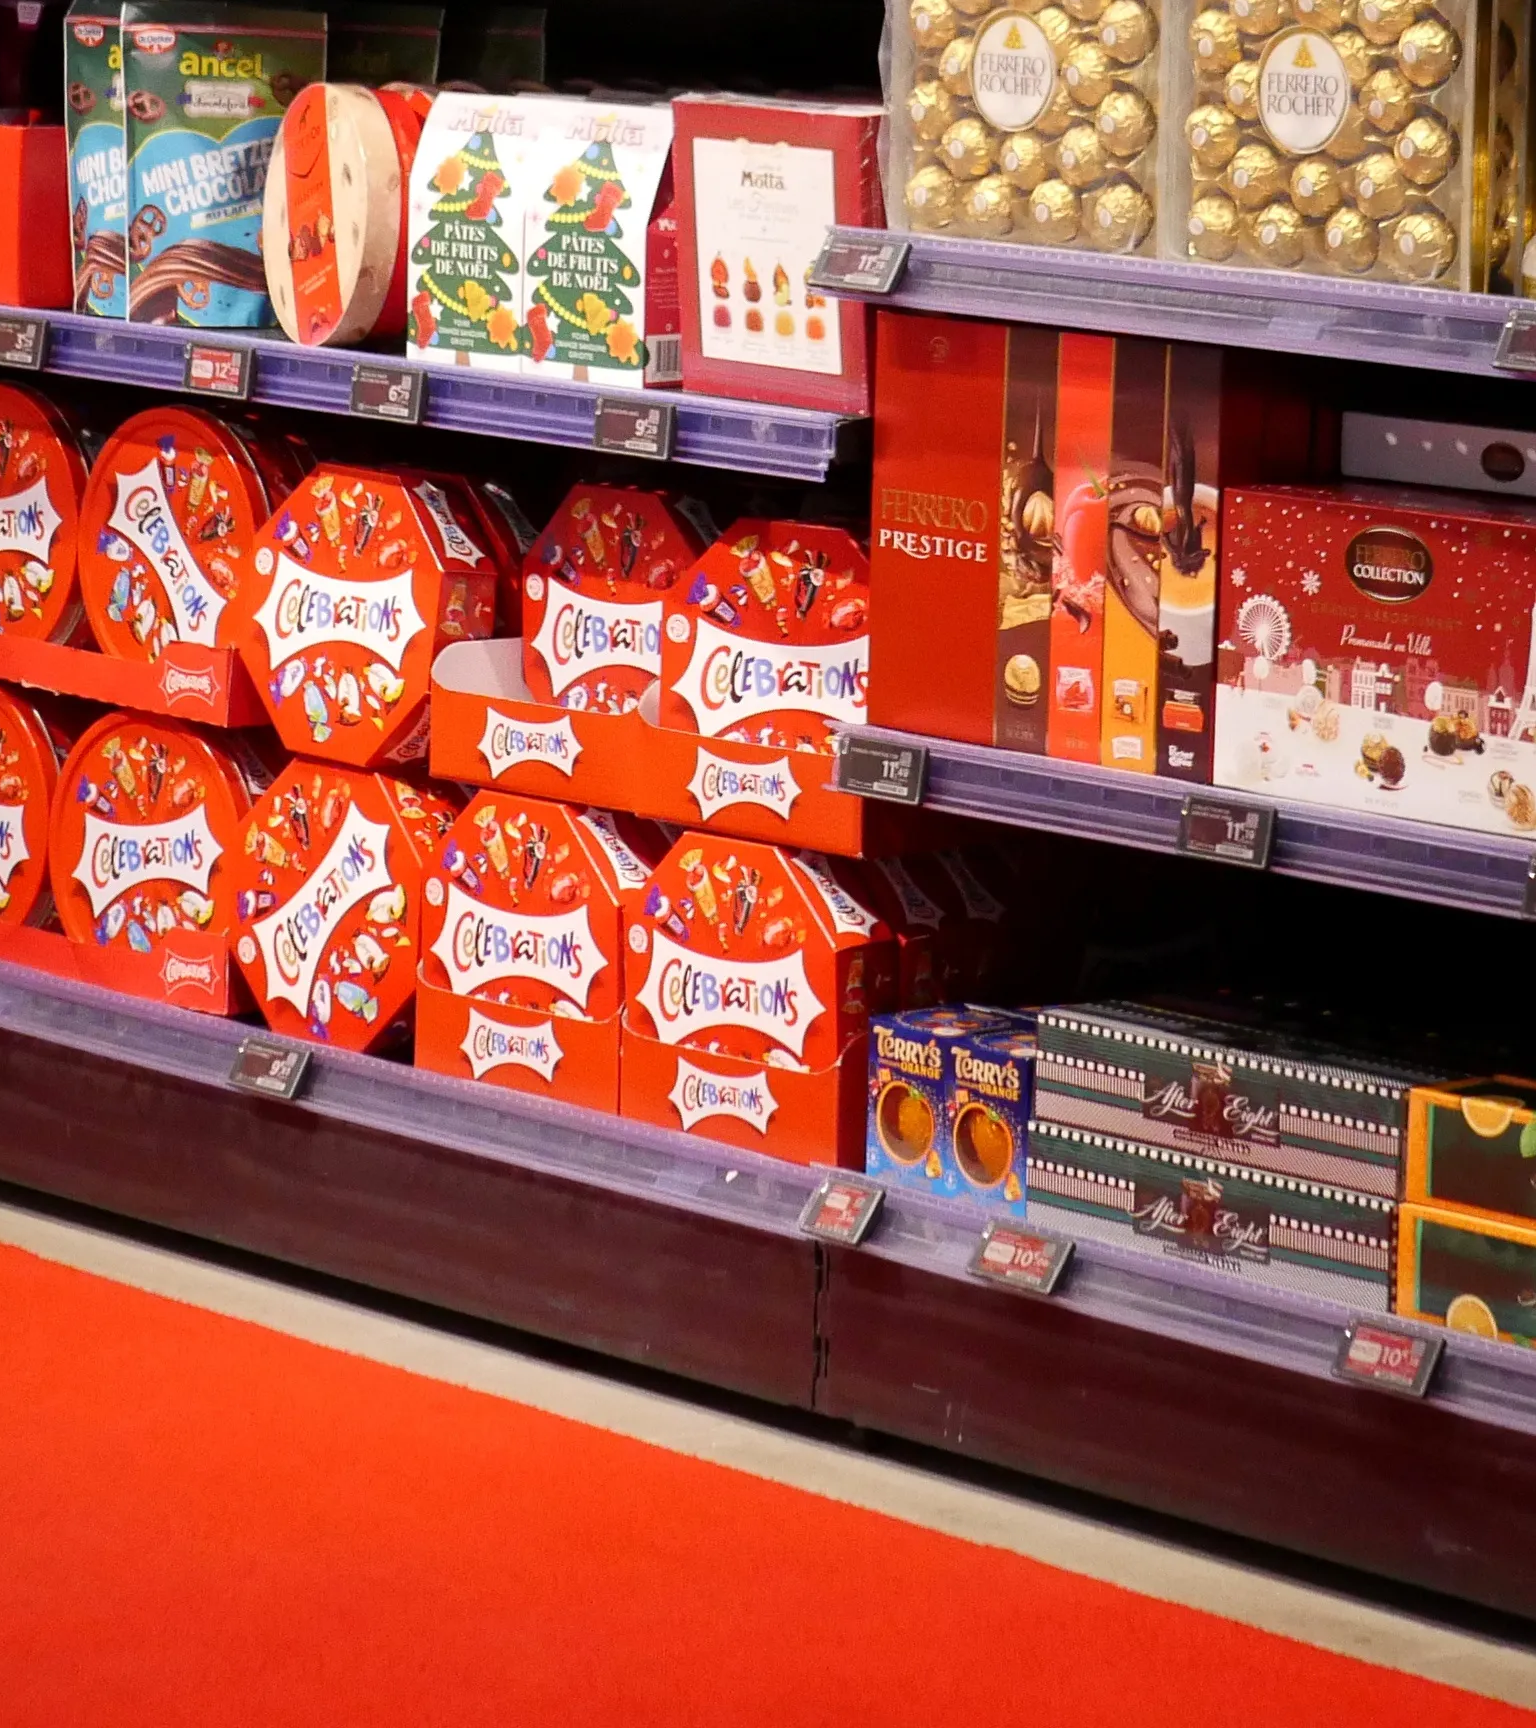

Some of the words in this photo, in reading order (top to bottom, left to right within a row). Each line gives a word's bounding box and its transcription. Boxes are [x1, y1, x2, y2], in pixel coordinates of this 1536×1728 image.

[179, 50, 263, 78] ancel
[979, 52, 1046, 77] FERRERO
[978, 72, 1044, 99] ROCHER
[1267, 72, 1340, 97] FERRERO
[1265, 92, 1338, 119] ROCHER
[142, 158, 189, 197] MINI
[741, 169, 786, 190] Motta
[443, 220, 486, 241] PÂTES
[561, 232, 605, 253] PÂTES
[431, 241, 449, 257] DE
[451, 241, 498, 262] FRUITS
[547, 252, 567, 270] DE
[570, 253, 619, 274] FRUITS
[435, 259, 455, 275] DE
[457, 256, 492, 280] NOËL
[552, 271, 571, 288] DE
[574, 269, 613, 292] NOËL
[880, 488, 989, 534] FERRERO
[878, 528, 988, 564] PRESTIGE
[1353, 563, 1425, 585] COLLECTION
[873, 1026, 942, 1068] TERRY'S
[901, 1062, 942, 1080] ORANGE
[951, 1046, 1020, 1088] TERRY'S
[979, 1082, 1020, 1101] ORANGE
[1143, 1081, 1199, 1118] After
[1223, 1094, 1280, 1135] Eight
[1127, 1197, 1189, 1233] After
[1213, 1210, 1268, 1251] Eight
